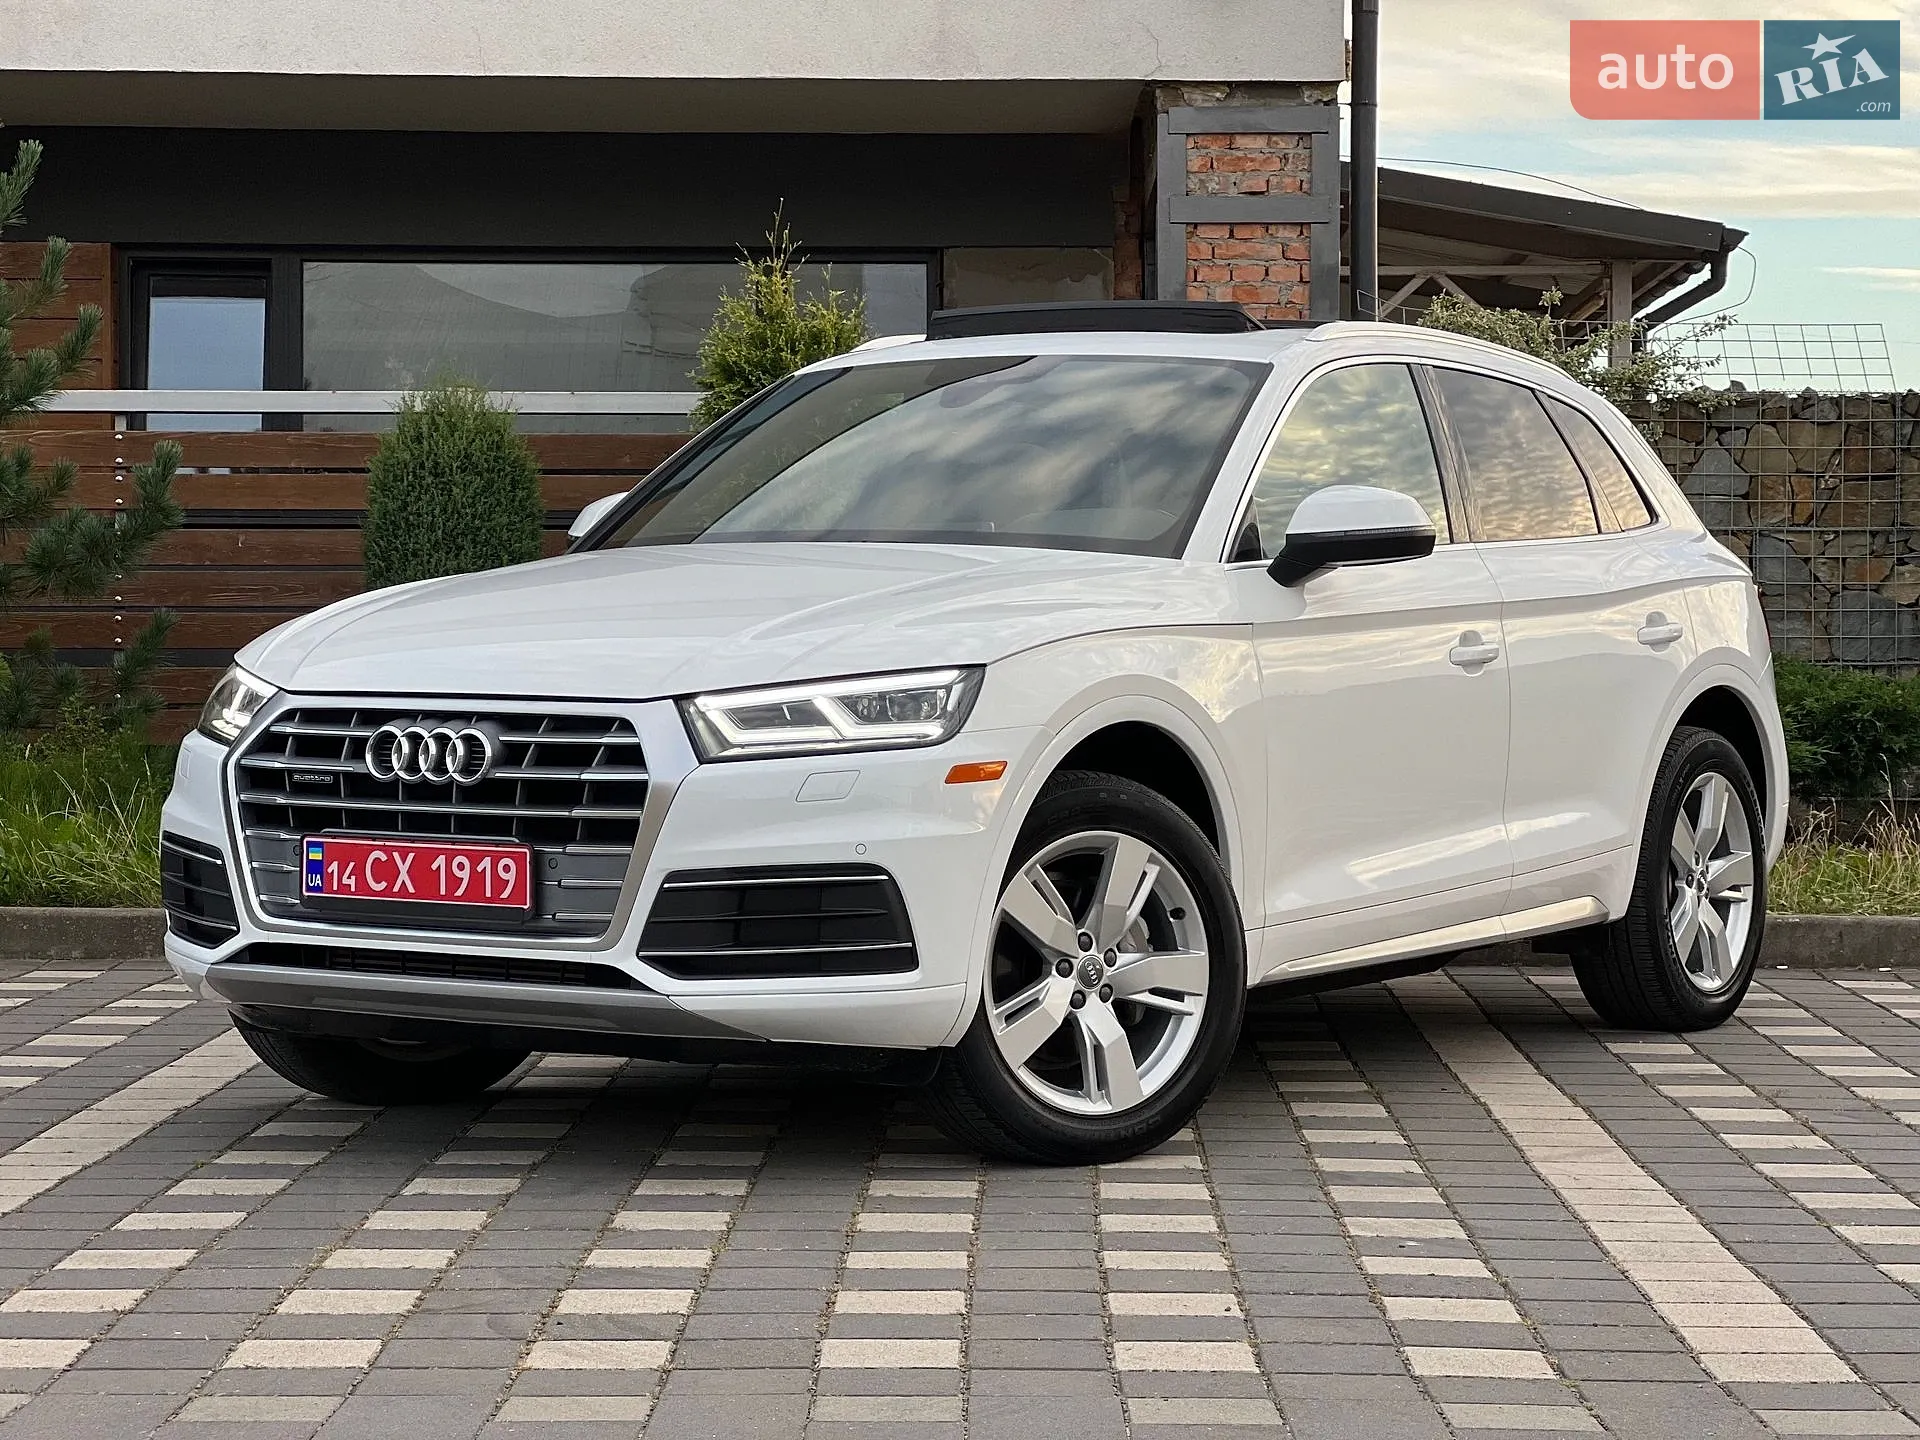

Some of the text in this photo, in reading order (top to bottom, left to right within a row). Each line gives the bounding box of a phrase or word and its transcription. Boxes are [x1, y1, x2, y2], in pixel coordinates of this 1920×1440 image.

[293, 774, 331, 782] quattro
[308, 874, 322, 887] UA
[327, 850, 517, 899] 14 CX 1919
